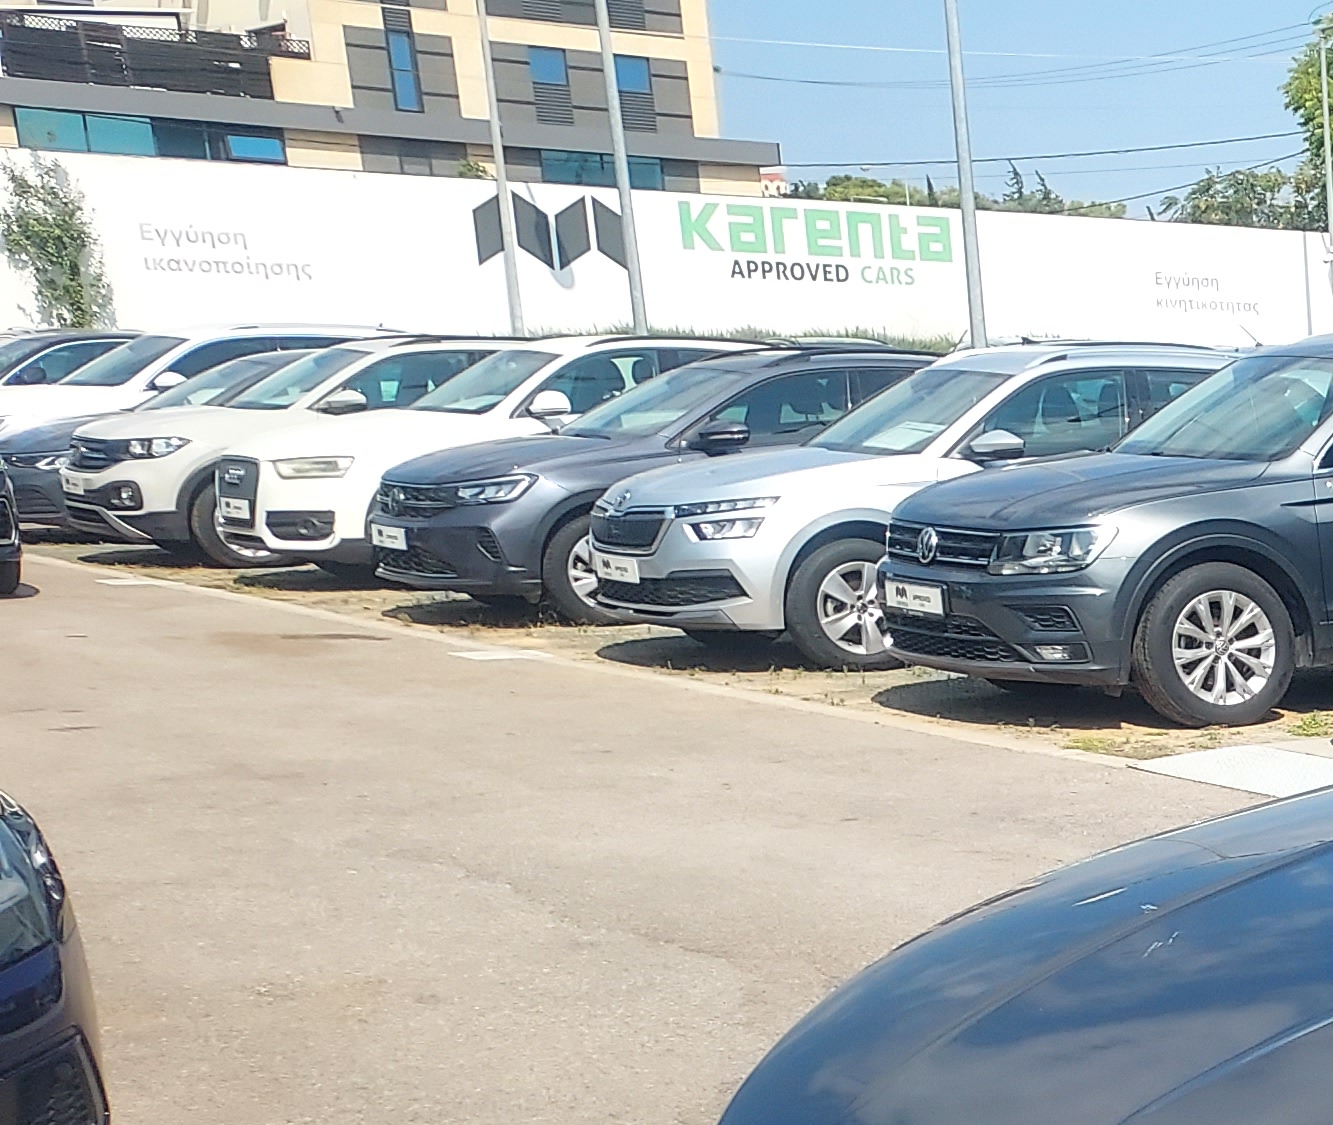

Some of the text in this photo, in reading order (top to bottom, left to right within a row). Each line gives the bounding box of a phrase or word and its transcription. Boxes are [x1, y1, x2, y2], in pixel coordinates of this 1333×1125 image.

[138, 222, 249, 251] Εγγύηση
[143, 255, 312, 282] ικανοποίησης
[730, 259, 916, 286] APPROVED CARS
[1155, 271, 1219, 292] Εγγύηση
